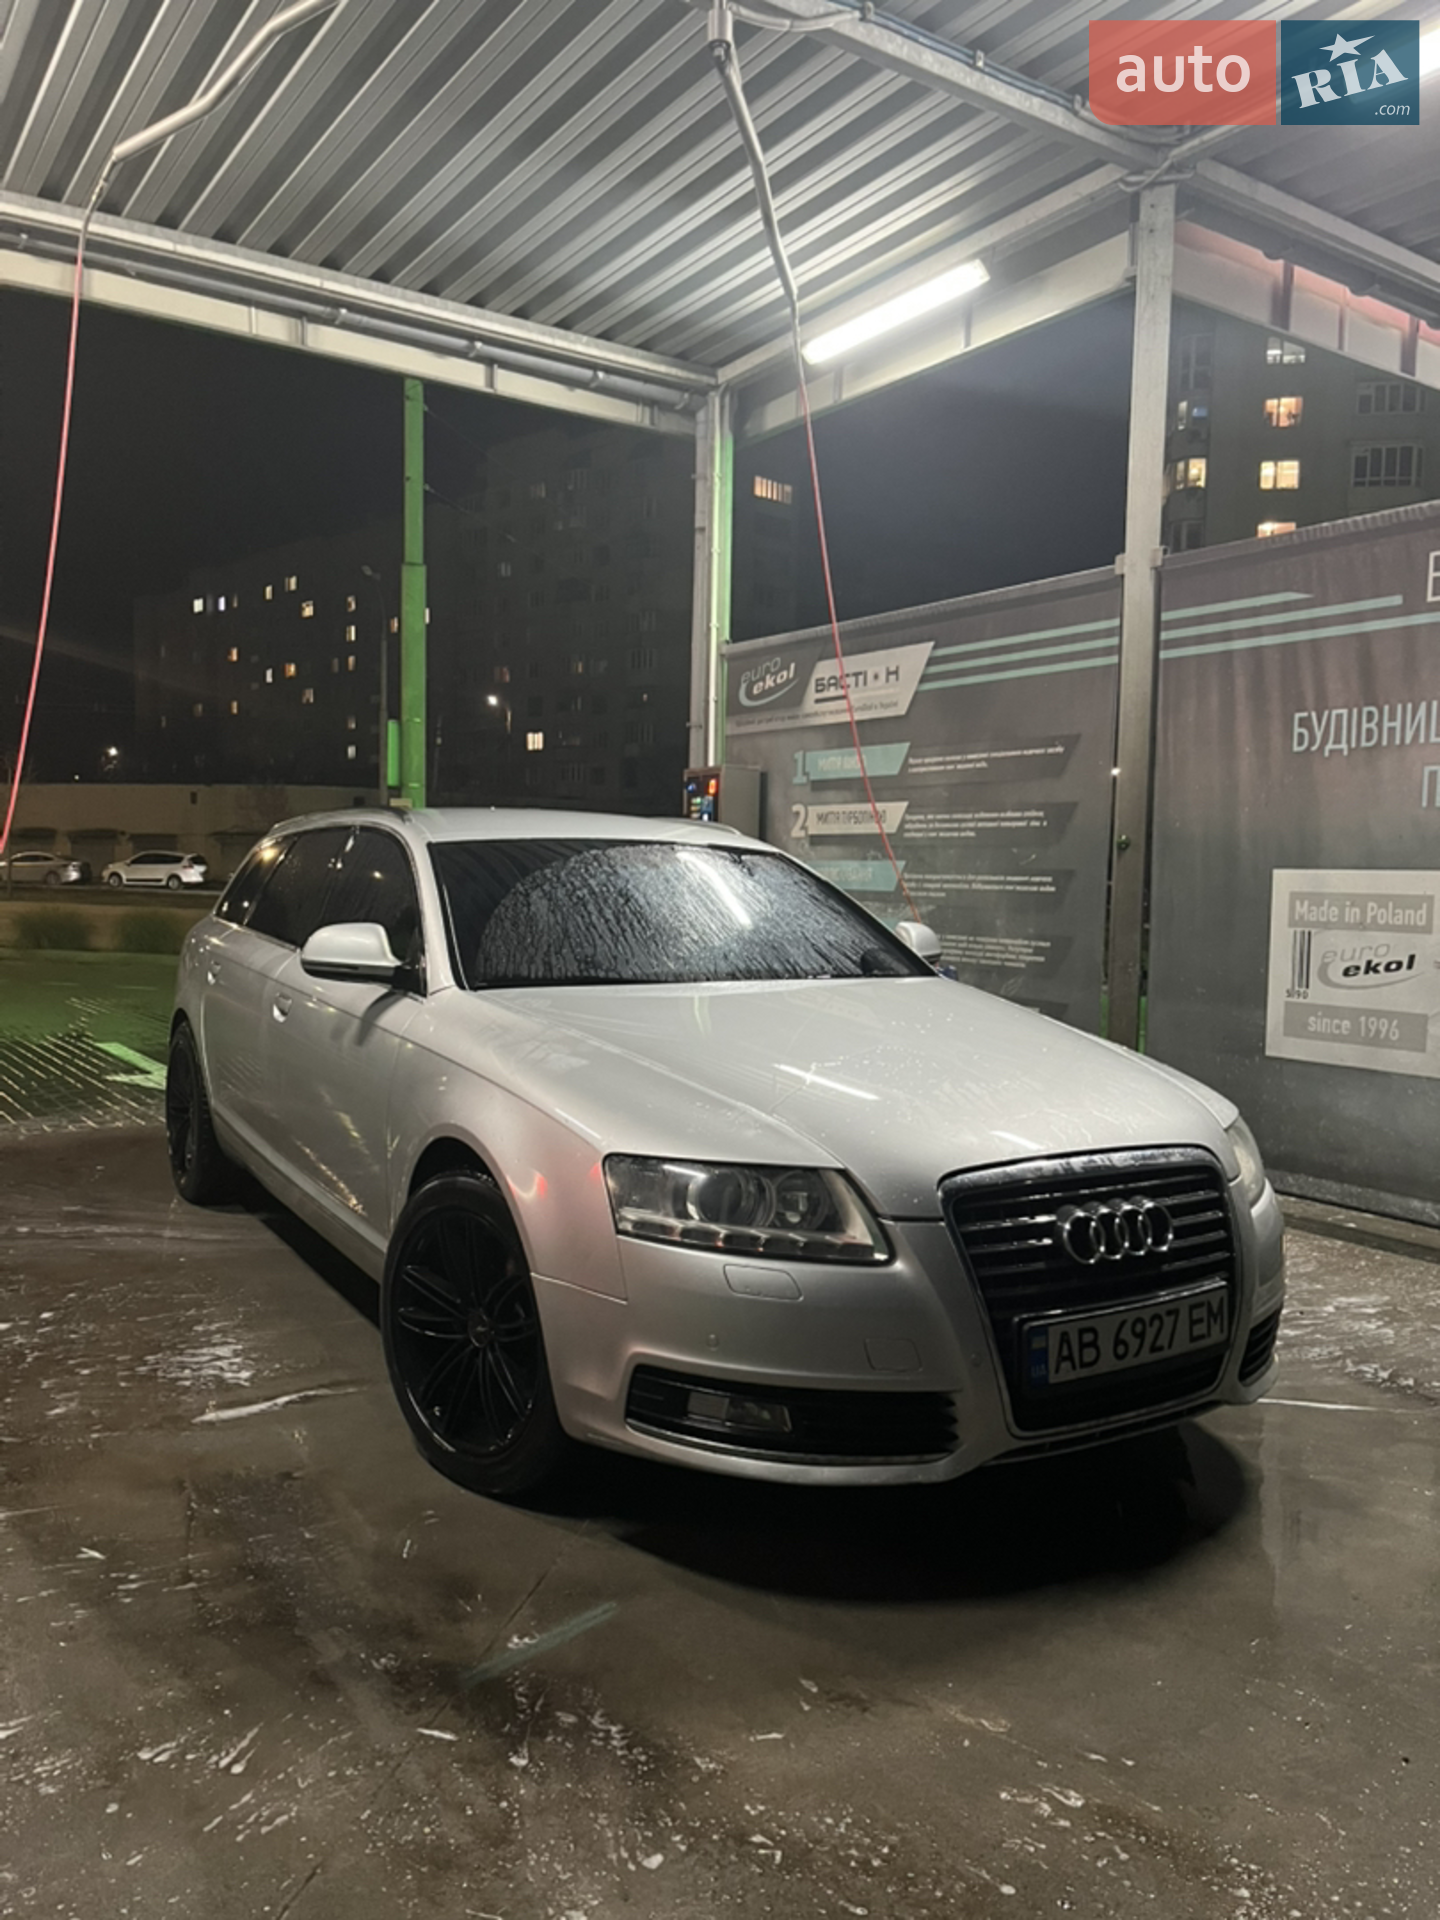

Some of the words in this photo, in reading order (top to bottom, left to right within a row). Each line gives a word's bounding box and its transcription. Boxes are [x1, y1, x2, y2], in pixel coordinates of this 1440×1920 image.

[741, 656, 782, 685] euro
[752, 662, 796, 696] ekol
[792, 750, 807, 785] 1
[791, 803, 806, 838] 2
[1294, 899, 1339, 922] Made
[1345, 901, 1361, 924] in
[1366, 901, 1427, 926] Poland
[1321, 943, 1391, 964] euro
[1342, 953, 1416, 978] ekol
[1307, 1011, 1351, 1035] since
[1358, 1016, 1400, 1041] 1996
[1054, 1326, 1099, 1375] AB
[1112, 1307, 1180, 1361] 6927
[1188, 1296, 1225, 1344] EM
